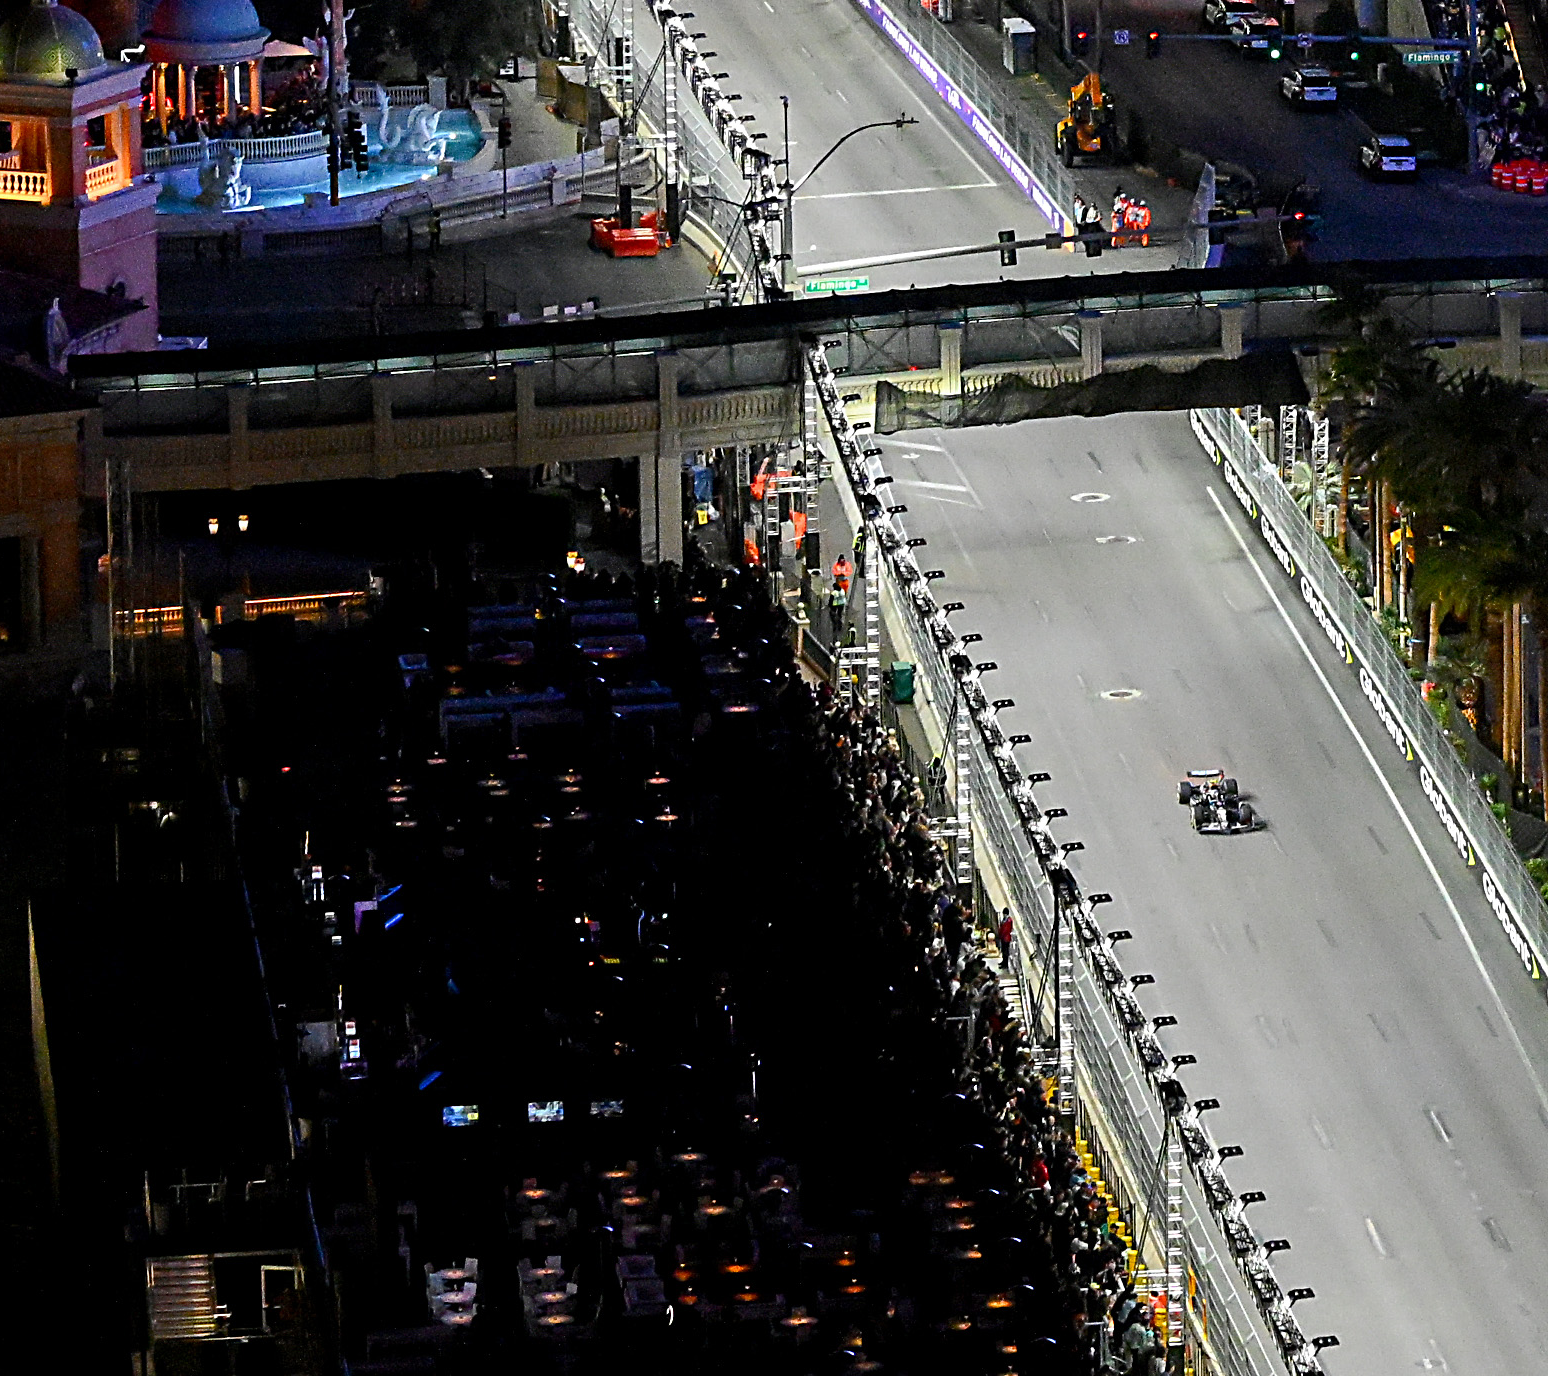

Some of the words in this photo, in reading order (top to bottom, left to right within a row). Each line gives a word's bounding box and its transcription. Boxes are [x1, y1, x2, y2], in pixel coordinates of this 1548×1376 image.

[1408, 52, 1452, 64] Flamingo
[810, 280, 857, 292] Flamingo
[1224, 460, 1254, 516] Globant
[1260, 514, 1292, 574] Globant
[1300, 576, 1347, 658] Globant
[1359, 667, 1407, 755] Globant
[1419, 765, 1468, 859] Globant
[1482, 871, 1532, 972] Globant
